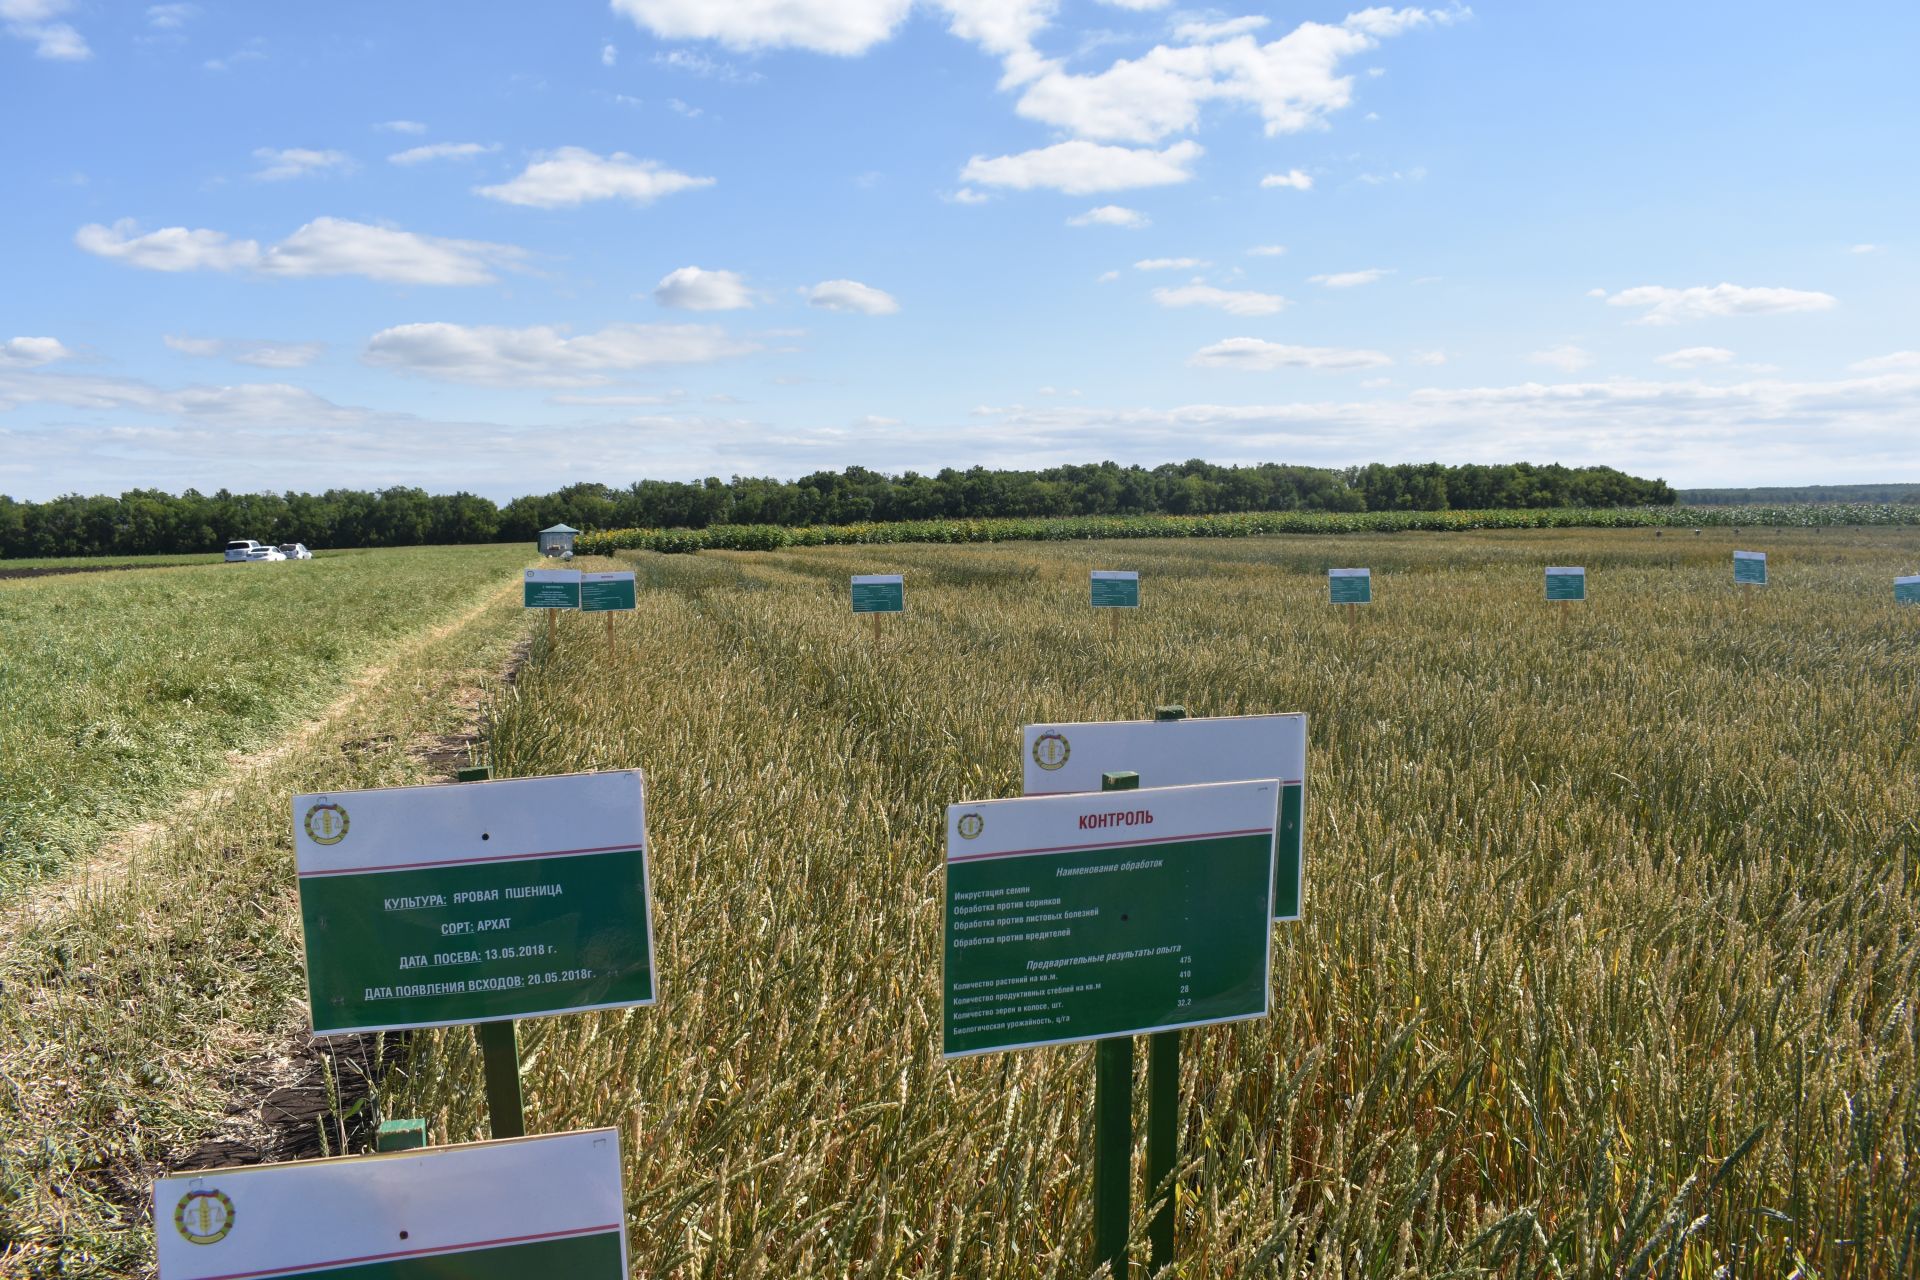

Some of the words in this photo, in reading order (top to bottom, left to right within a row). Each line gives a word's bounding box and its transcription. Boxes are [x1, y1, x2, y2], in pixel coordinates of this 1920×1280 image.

[1079, 810, 1154, 830] КОНТРОЛЬ
[1056, 863, 1118, 876] Наименование
[1120, 860, 1164, 872] обработок
[384, 895, 447, 910] КУЛЬТУРА:
[454, 890, 498, 904] ЯРОВАЯ
[505, 884, 562, 899] ПШЕНИЦА
[954, 888, 1004, 900] Инкрустация
[1006, 886, 1030, 895] семян
[954, 903, 994, 915] Обработка
[997, 900, 1024, 912] против
[1026, 898, 1061, 909] сорняков
[441, 922, 474, 936] СОРТ:
[477, 918, 512, 932] АРХАТ
[954, 918, 994, 930] Обработка
[997, 914, 1024, 926] против
[1026, 912, 1062, 922] листовых
[1064, 907, 1099, 918] болезней
[954, 936, 994, 948] Обработка
[996, 932, 1024, 944] против
[1026, 928, 1070, 941] вредителей
[400, 954, 428, 970] ДАТА
[434, 952, 482, 966] ПОСЕВА:
[485, 944, 544, 960] 13.05.2018
[548, 945, 558, 954] г.
[1026, 954, 1104, 970] Предварительные
[1106, 948, 1155, 962] результаты
[1156, 944, 1182, 954] опыта
[1180, 956, 1192, 964] 475
[364, 986, 392, 1001] ДАТА
[396, 982, 464, 997] ПОЯВЛЕНИЯ
[468, 976, 525, 991] ВСХОДОВ:
[528, 969, 596, 986] 20.05.2018г.
[953, 980, 994, 991] Количество
[995, 975, 1028, 986] растений
[1039, 973, 1058, 982] кв.м.
[1180, 985, 1189, 993] 28
[953, 994, 994, 1006] Количество
[995, 990, 1045, 1002] продуктивных
[1047, 985, 1074, 995] стеблей
[1086, 982, 1102, 991] кв.м
[953, 1009, 994, 1020] Количество
[995, 1006, 1016, 1017] зерен
[1052, 1002, 1064, 1010] шт.
[953, 1023, 1006, 1035] Биологическая
[1007, 1017, 1054, 1029] урожайность,
[1056, 1014, 1070, 1024] ц/га
